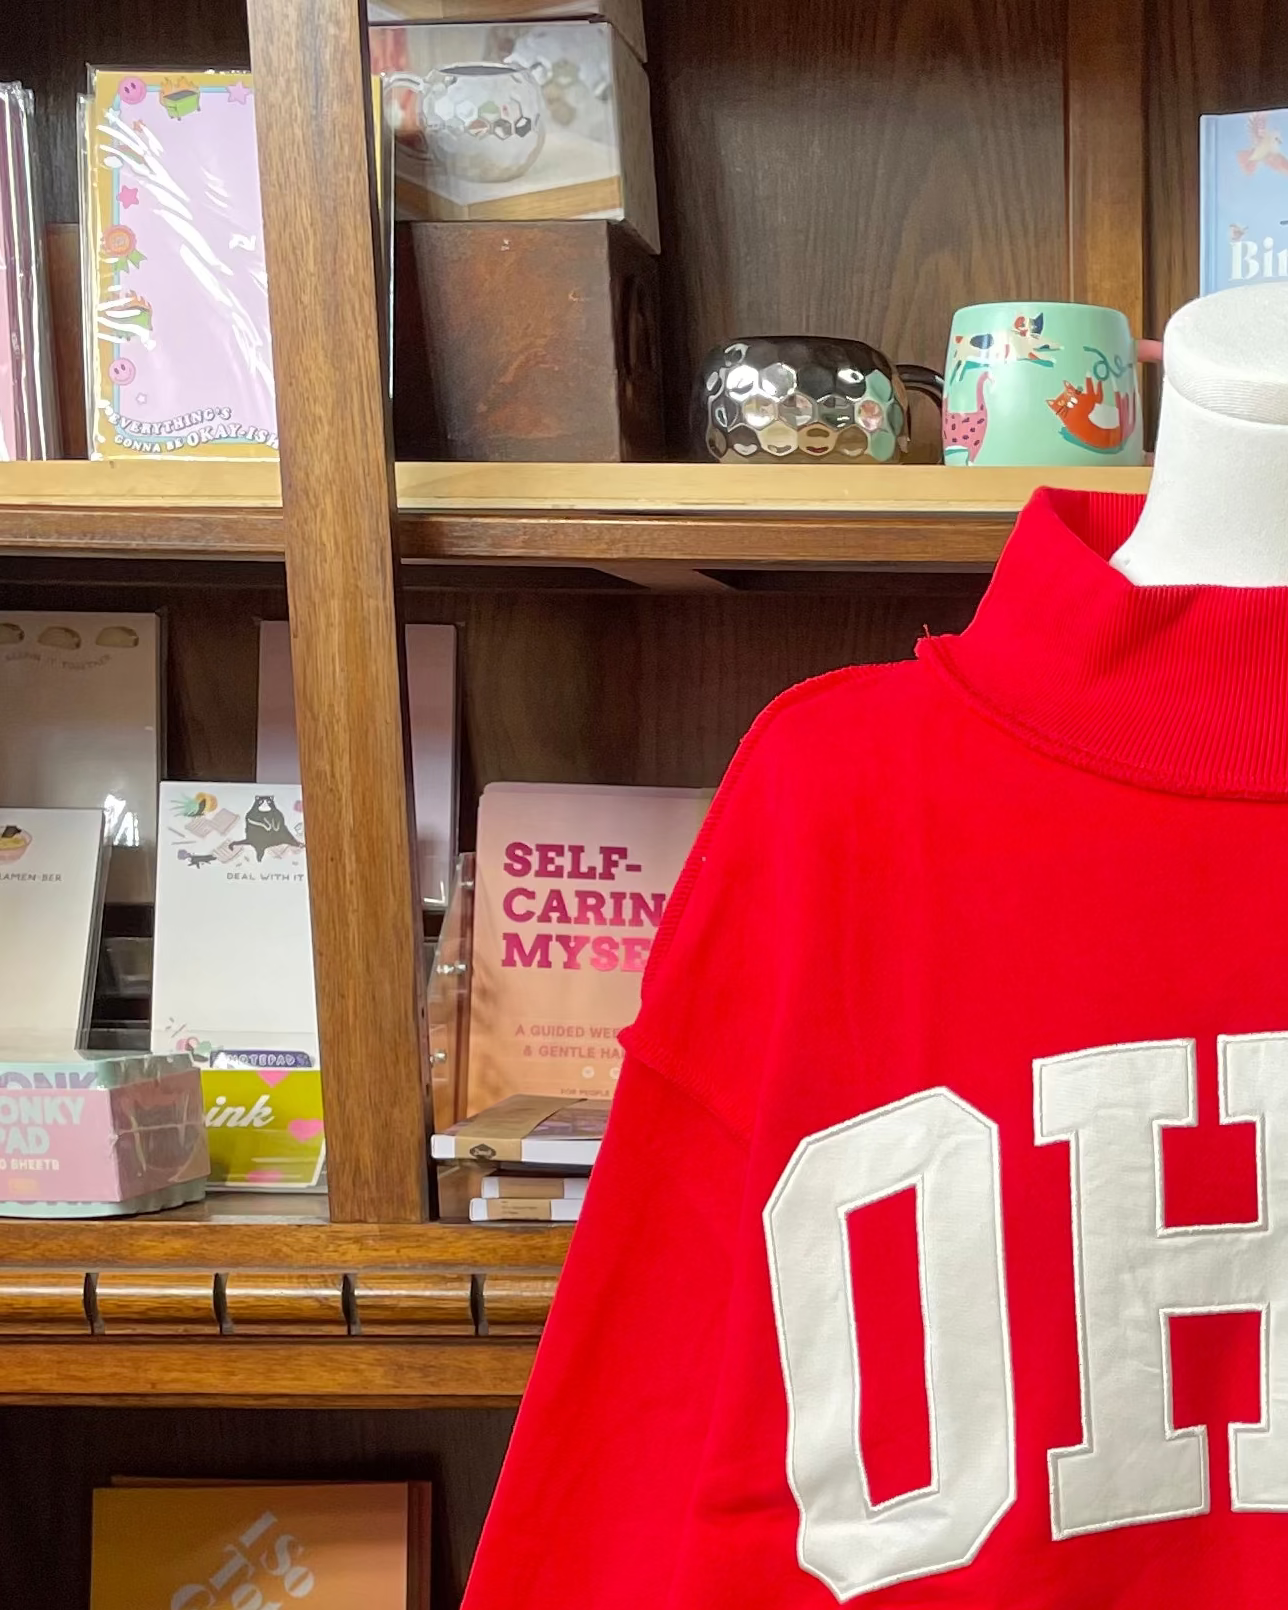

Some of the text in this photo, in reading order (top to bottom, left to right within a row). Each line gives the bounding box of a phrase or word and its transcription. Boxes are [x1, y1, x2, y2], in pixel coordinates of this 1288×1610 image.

[114, 433, 162, 454] GONNA
[166, 436, 185, 452] BE
[503, 841, 642, 881] SELF-
[226, 872, 305, 882] DEAL WITH IT
[502, 887, 667, 928] CARIN
[501, 932, 652, 972] MYSE
[515, 1024, 619, 1039] A GUIDED WEE
[538, 1046, 595, 1059] GENTLE
[600, 1048, 626, 1060] HA
[0, 1094, 85, 1125] ONKY
[204, 1094, 276, 1128] ink
[0, 1126, 50, 1156] AD
[259, 1534, 315, 1598] So
